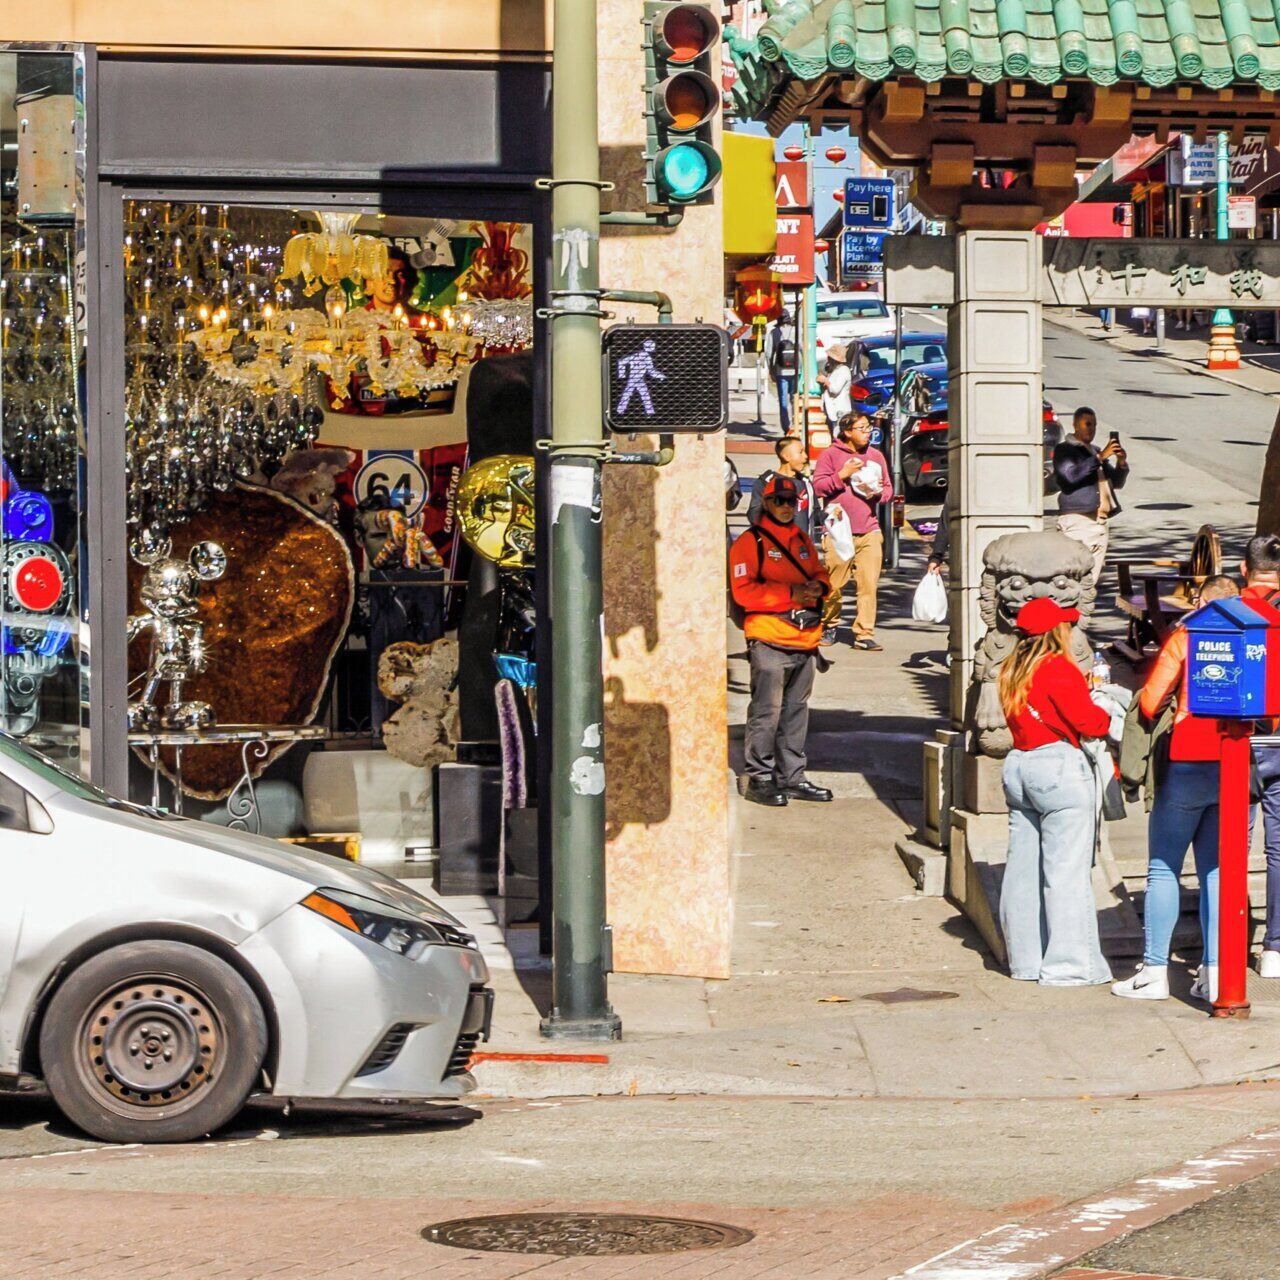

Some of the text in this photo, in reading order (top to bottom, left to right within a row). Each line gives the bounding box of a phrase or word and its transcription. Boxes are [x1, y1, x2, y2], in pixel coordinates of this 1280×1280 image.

[847, 181, 892, 195] Pay here
[846, 234, 879, 246] Pay by
[846, 243, 881, 253] License
[367, 472, 415, 507] 64
[443, 466, 461, 534] GOODYEAR
[1198, 641, 1232, 652] POLICE
[1195, 652, 1235, 662] TELEPHONE
